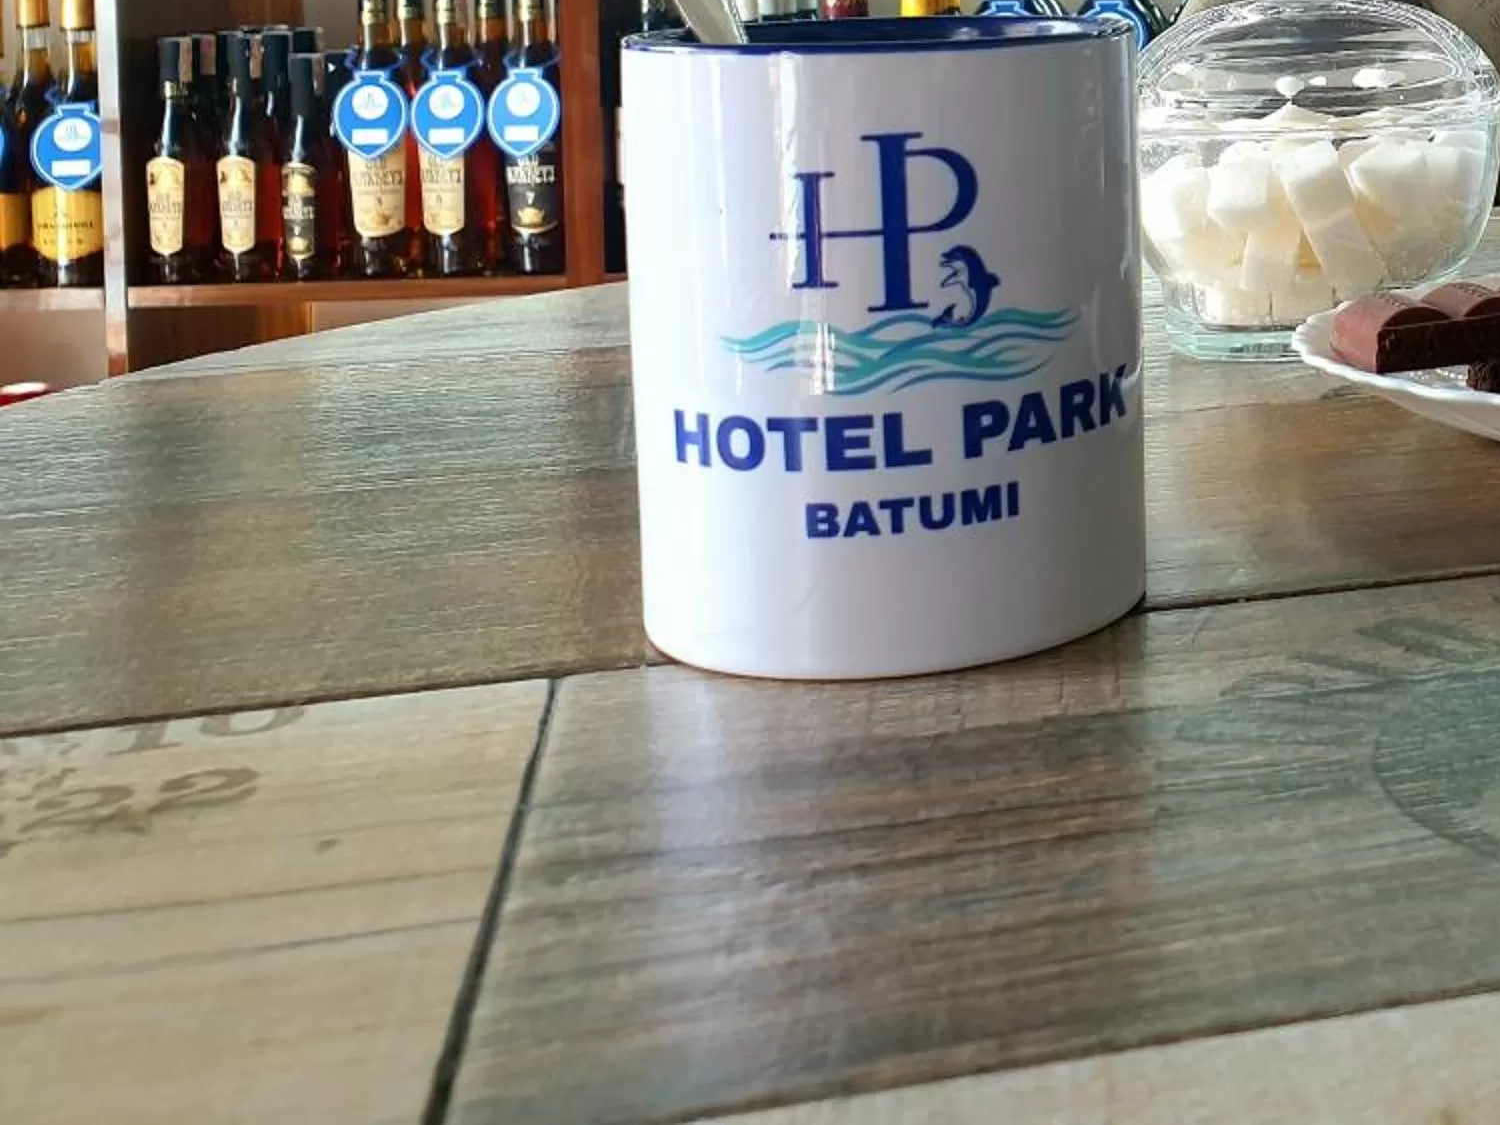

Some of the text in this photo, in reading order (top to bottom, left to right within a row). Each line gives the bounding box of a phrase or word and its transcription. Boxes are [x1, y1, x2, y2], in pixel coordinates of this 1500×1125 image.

[673, 363, 1131, 473] HOTEL PARK
[805, 481, 1021, 540] BATUMI
